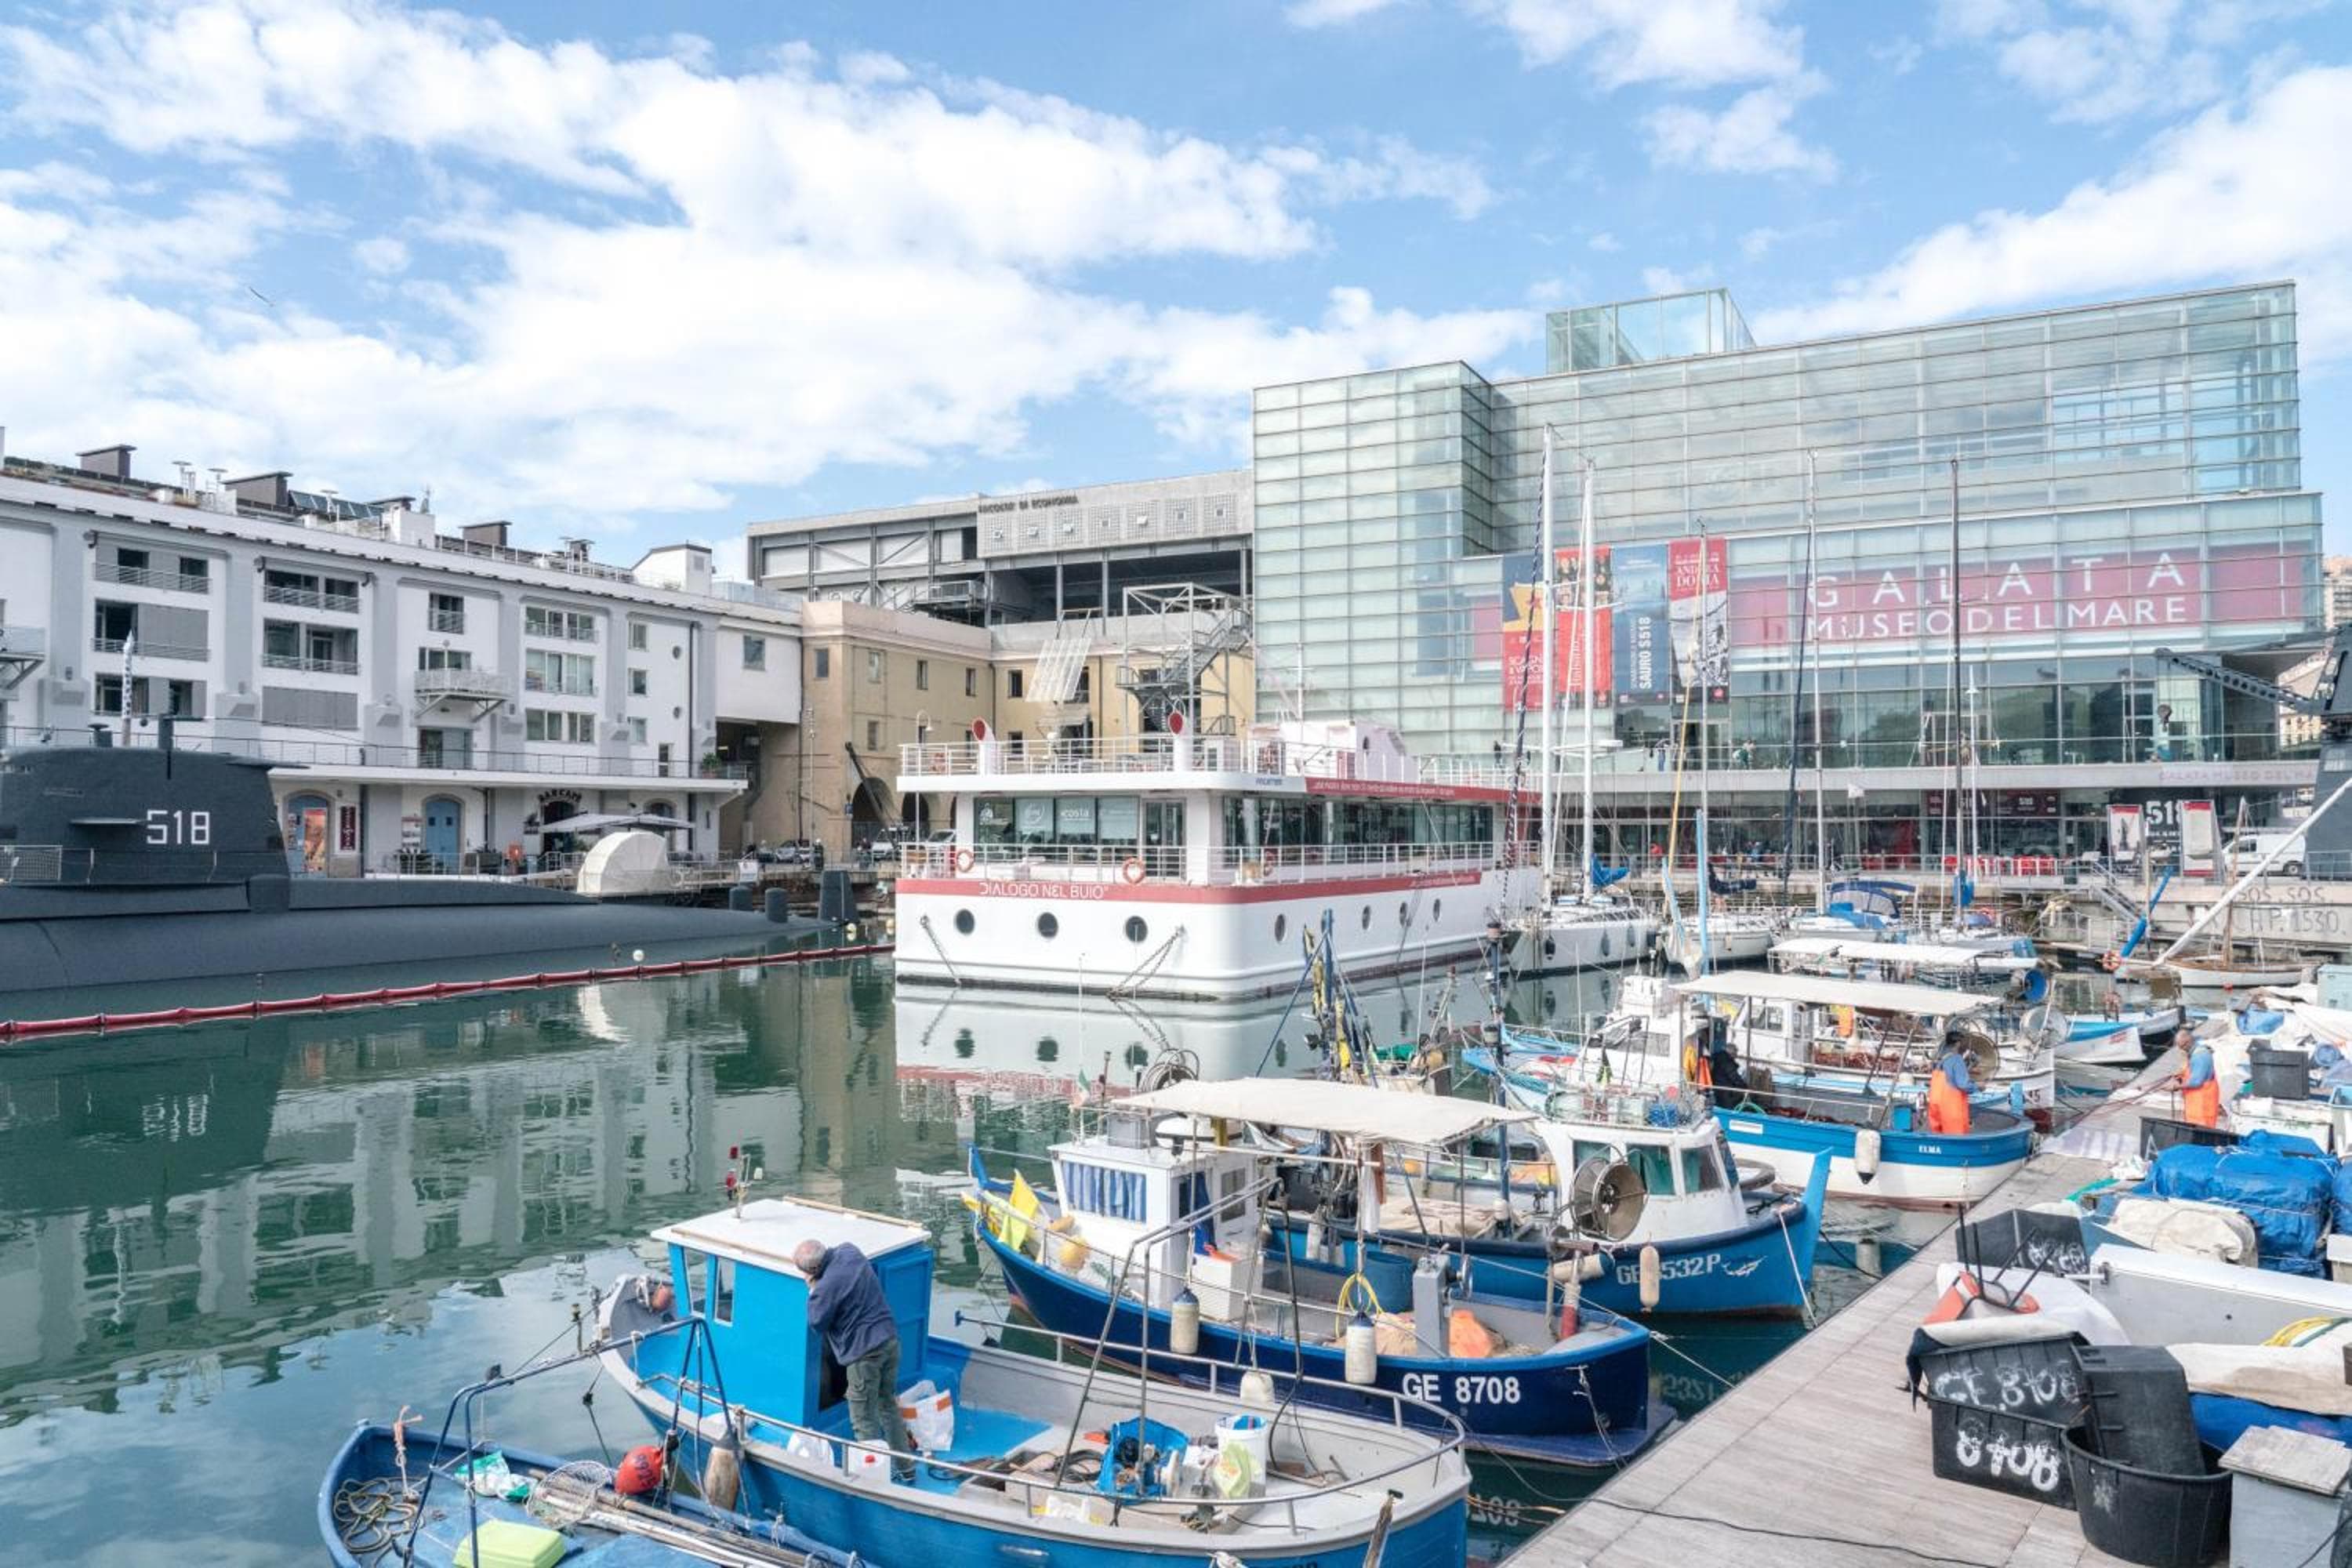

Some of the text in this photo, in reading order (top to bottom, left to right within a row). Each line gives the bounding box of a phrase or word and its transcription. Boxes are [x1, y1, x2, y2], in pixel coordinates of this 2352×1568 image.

[1807, 551, 2186, 608] GALATA
[1807, 597, 2187, 641] MUSEO DEL MARE
[1639, 616, 1652, 690] SAURO S518
[147, 810, 210, 845] 518
[980, 883, 1039, 898] DIALOGO
[1043, 884, 1067, 898] NEL
[1402, 1374, 1521, 1405] GE 8708
